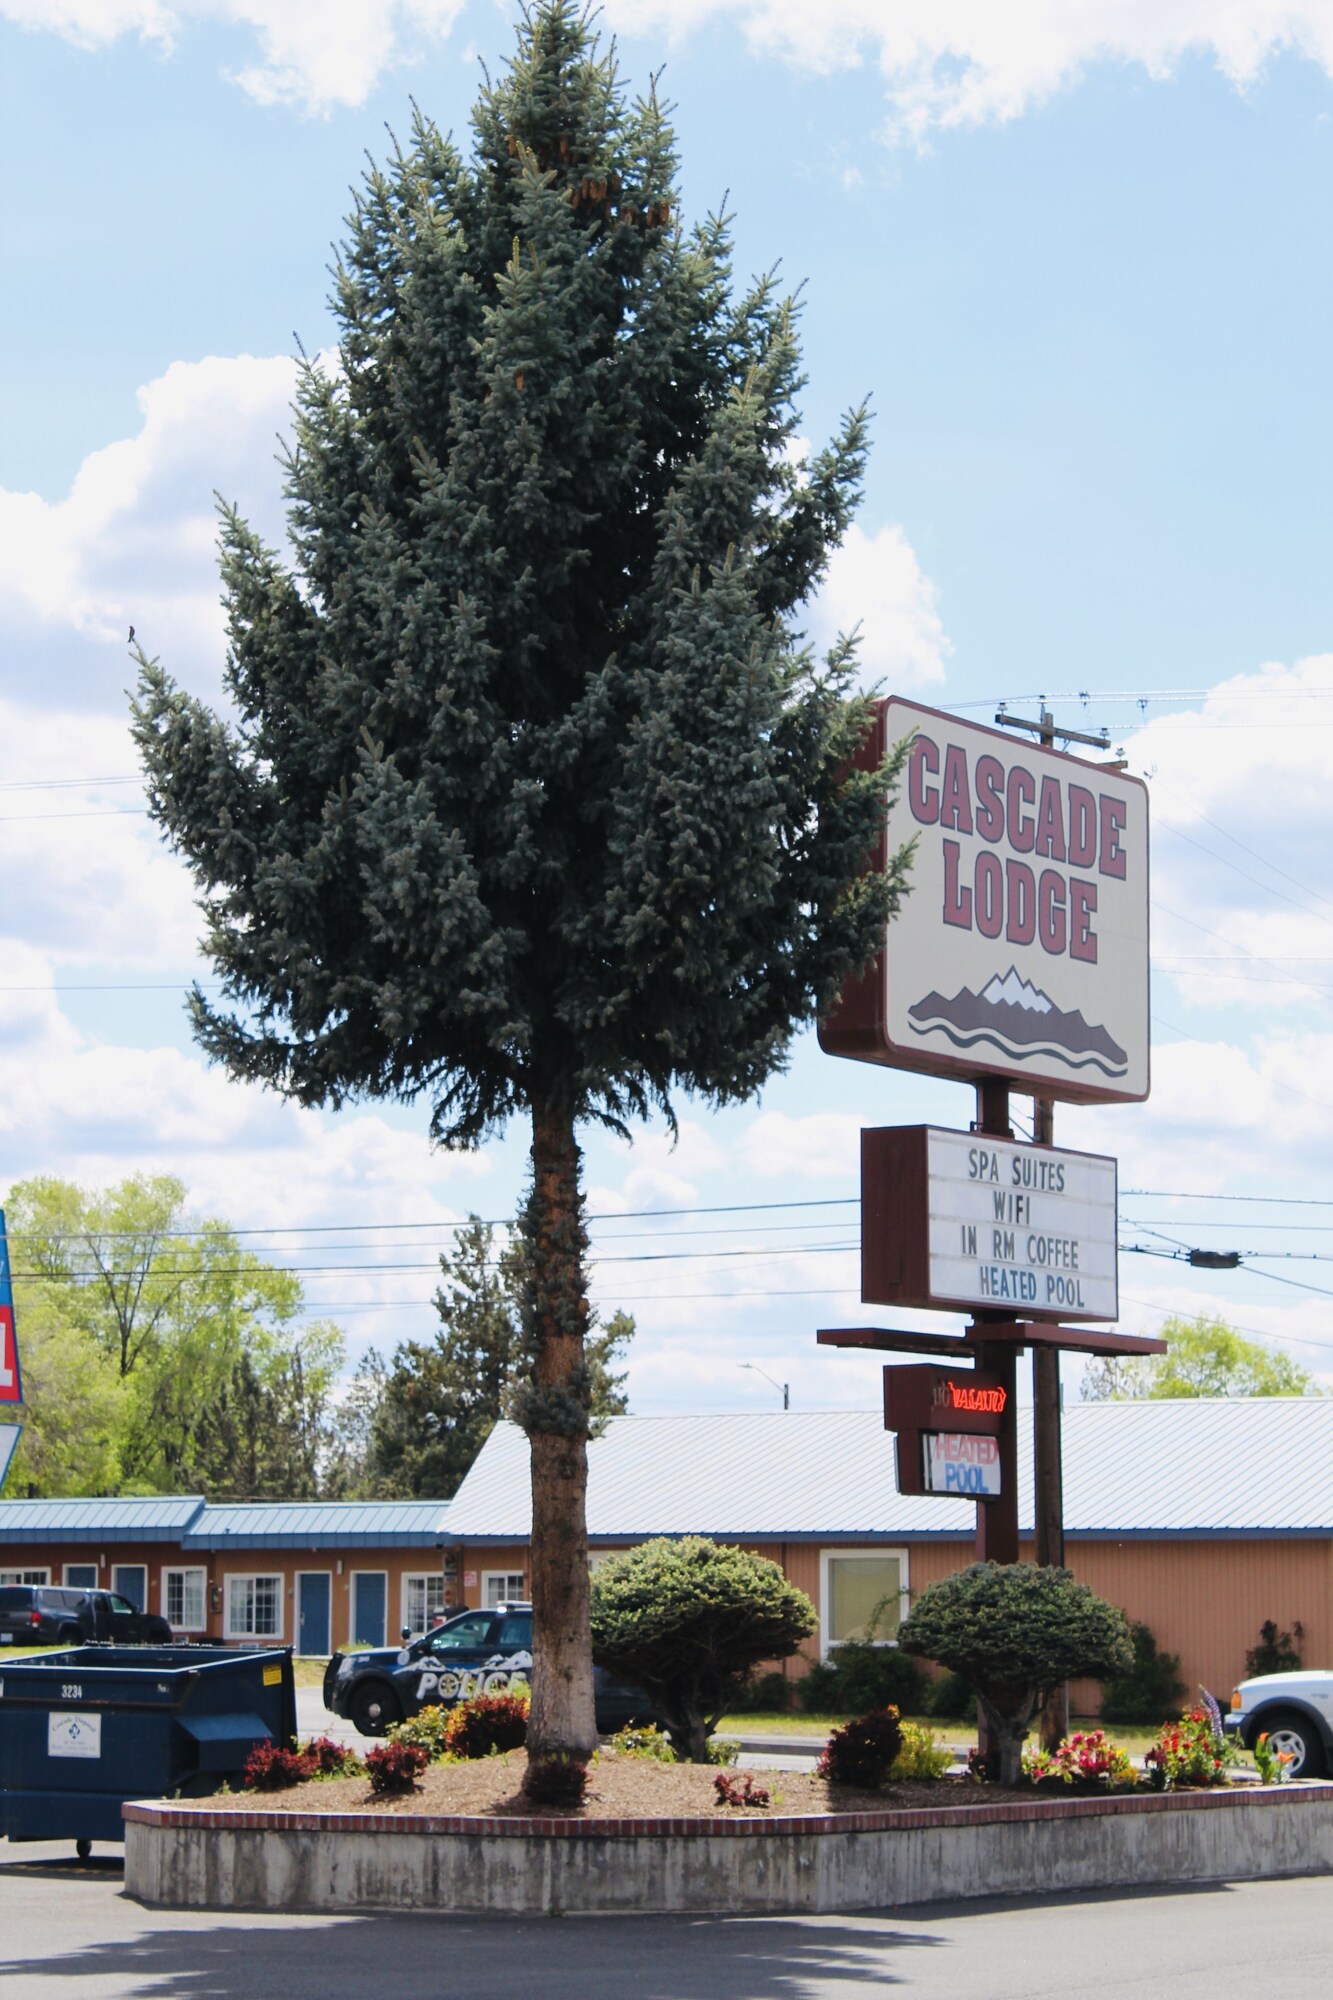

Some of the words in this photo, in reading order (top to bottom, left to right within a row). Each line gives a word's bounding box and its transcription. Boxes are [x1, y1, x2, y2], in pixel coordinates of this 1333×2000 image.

[908, 734, 1127, 881] CASCADE
[942, 838, 1098, 965] LODGE
[968, 1148, 999, 1182] SPA
[1011, 1155, 1065, 1193] SUITES
[993, 1189, 1031, 1226] WIFI
[961, 1224, 977, 1256] IN
[993, 1229, 1015, 1261] RM
[1027, 1234, 1079, 1270] COFFEE
[980, 1265, 1037, 1301] HEATED
[1046, 1274, 1085, 1308] POOL
[935, 1434, 1000, 1465] HEATED
[944, 1462, 989, 1493] POOL
[61, 1684, 82, 1699] 3234
